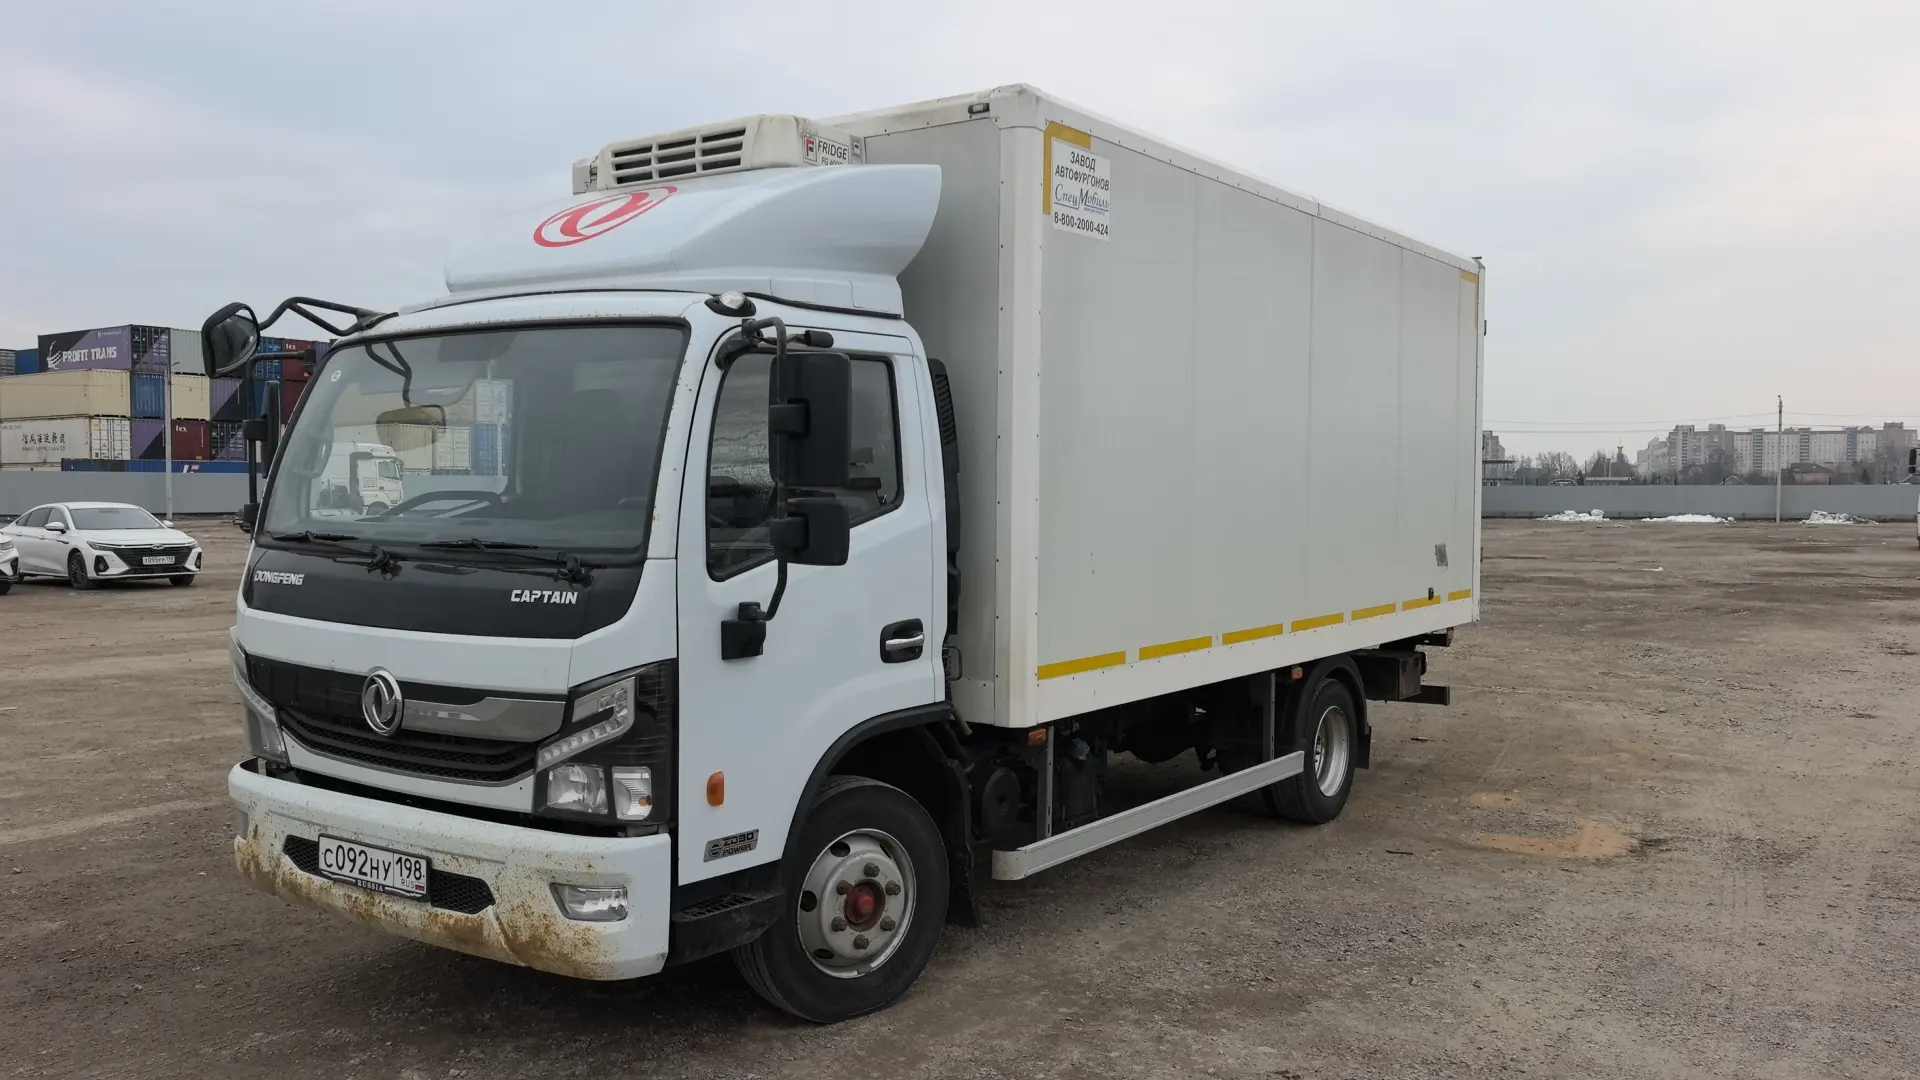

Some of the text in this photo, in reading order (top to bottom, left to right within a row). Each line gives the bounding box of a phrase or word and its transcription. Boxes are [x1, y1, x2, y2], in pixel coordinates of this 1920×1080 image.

[817, 140, 848, 160] FRIDGE
[1070, 151, 1096, 173] ЗАВОД
[1055, 164, 1110, 191] АВТОФУРГОНОВ
[1054, 211, 1109, 236] 8-800-2000-424
[62, 345, 117, 363] PROFIT TRANS
[254, 570, 306, 586] DONGFENG
[510, 589, 578, 605] CAPTAIN
[722, 844, 752, 856] POWER
[395, 856, 422, 881] 198
[357, 880, 384, 892] RUSSIA
[401, 880, 415, 889] RUS
